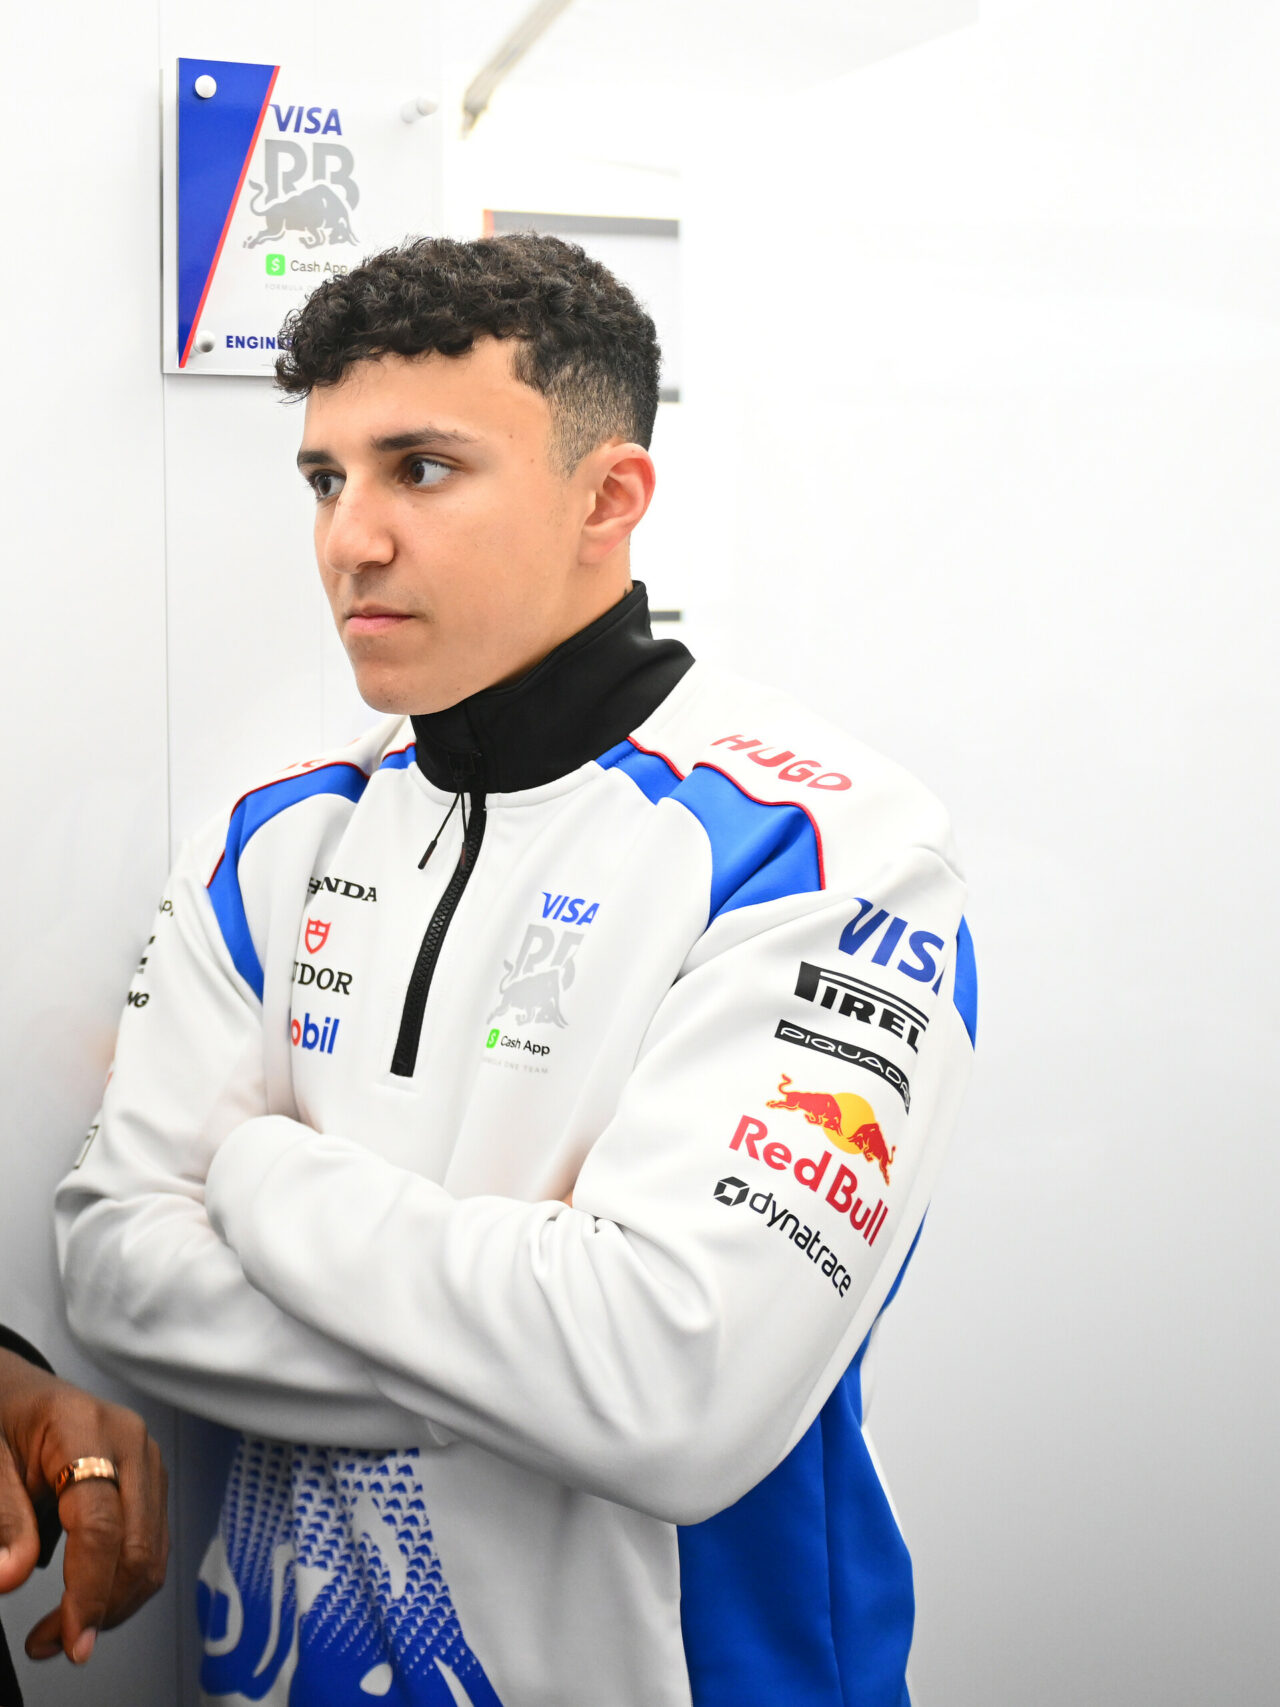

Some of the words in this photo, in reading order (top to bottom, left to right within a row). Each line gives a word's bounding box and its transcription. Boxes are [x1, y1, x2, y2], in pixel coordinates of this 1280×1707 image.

[268, 104, 342, 136] VISA
[290, 259, 320, 273] Cash
[323, 261, 348, 274] App
[226, 335, 292, 350] ENGIN
[710, 734, 853, 791] HUGO
[542, 891, 600, 926] VISA
[838, 897, 945, 996] VIS
[289, 1008, 340, 1054] obil
[500, 1035, 521, 1049] Cash
[523, 1040, 551, 1056] App
[729, 1114, 833, 1193] Red
[825, 1163, 889, 1248] Bull
[749, 1192, 852, 1298] dynatrace
